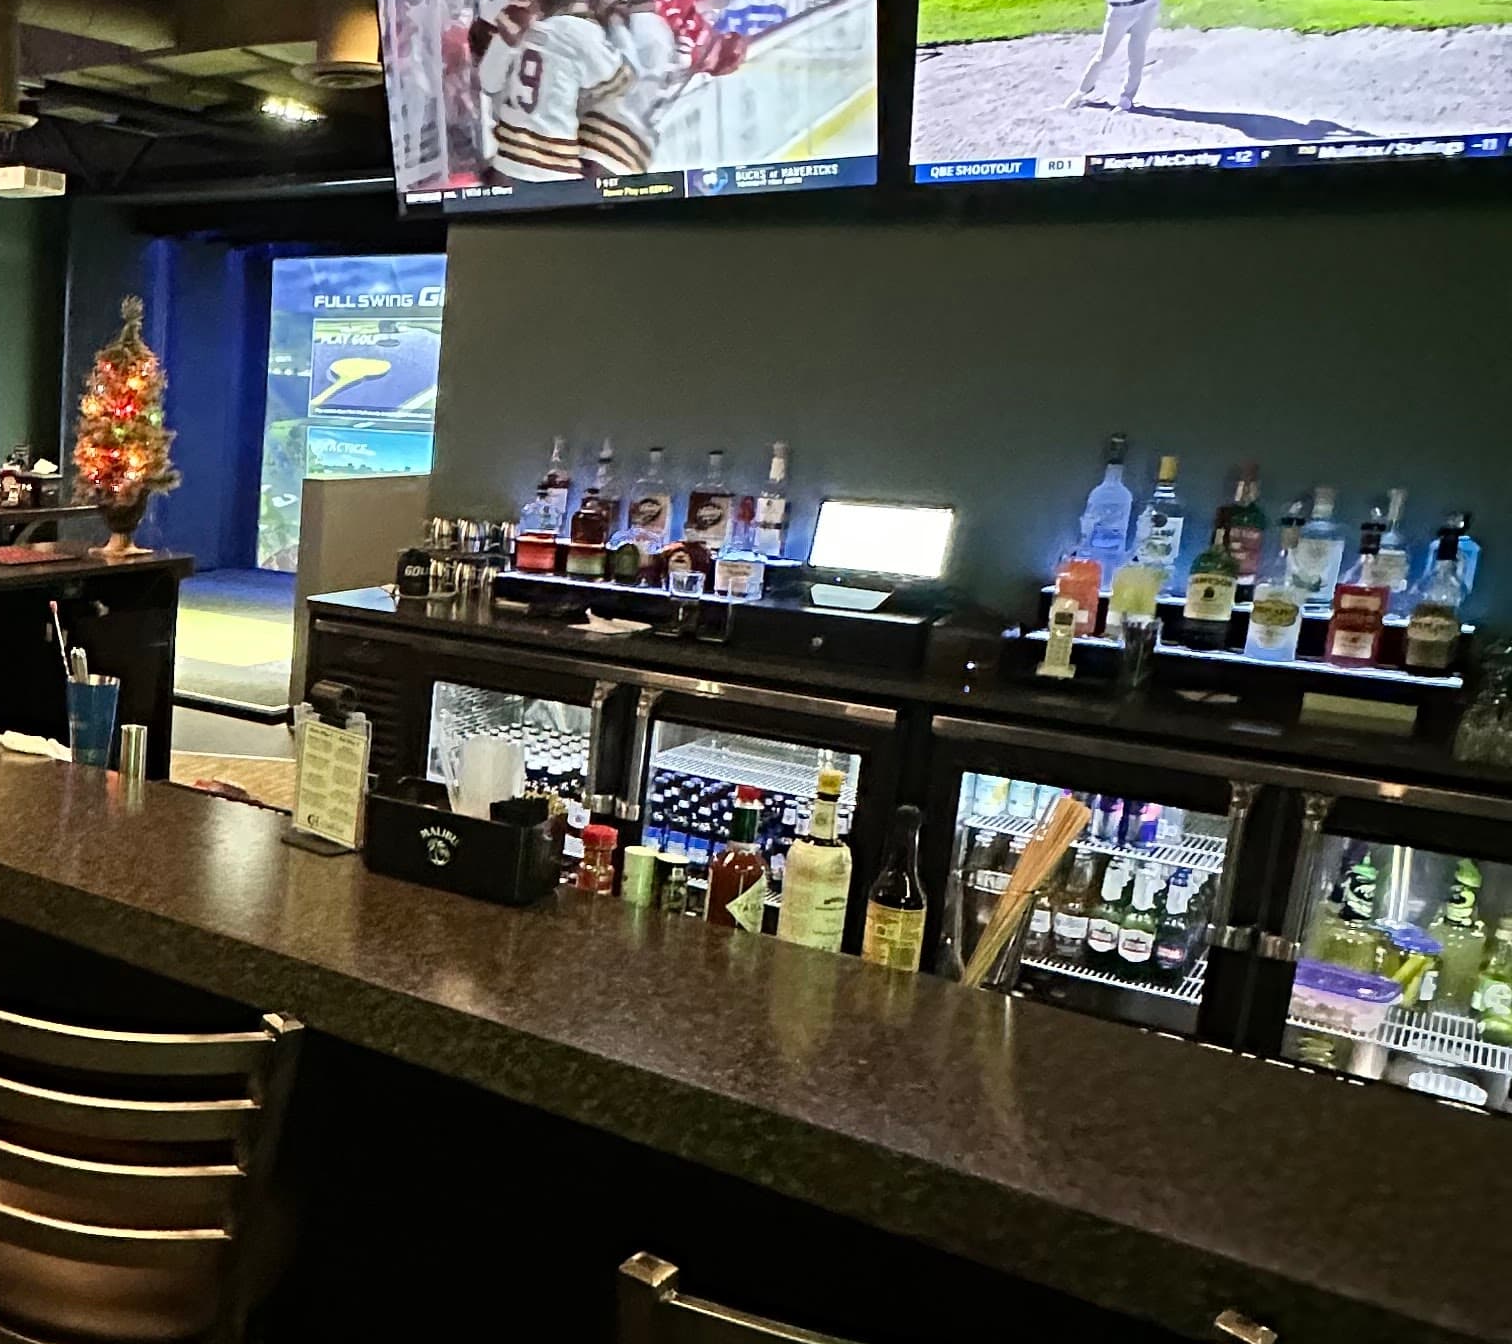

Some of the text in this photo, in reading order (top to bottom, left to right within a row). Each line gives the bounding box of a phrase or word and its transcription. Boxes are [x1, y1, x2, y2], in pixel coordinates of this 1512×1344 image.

[781, 164, 838, 177] MAVERICKS
[955, 162, 1023, 177] SHOOTOUT
[1047, 160, 1065, 172] RD
[314, 294, 357, 308] FULL
[359, 293, 414, 308] SWING
[320, 333, 381, 346] PLAY GOLF
